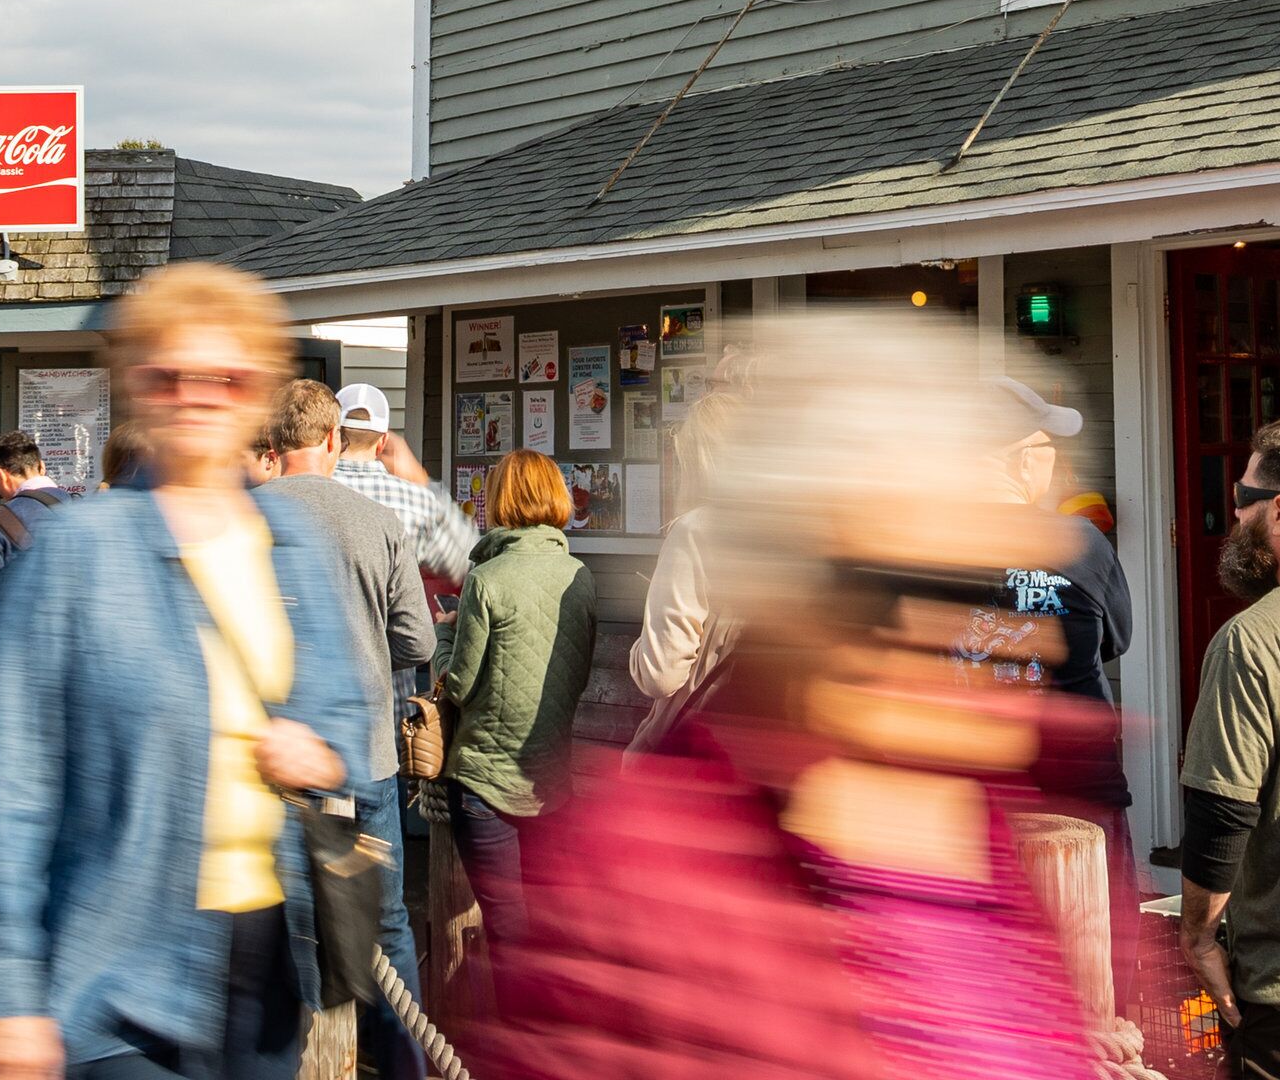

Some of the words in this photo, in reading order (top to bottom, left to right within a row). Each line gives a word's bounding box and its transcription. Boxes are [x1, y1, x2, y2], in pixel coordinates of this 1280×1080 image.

[468, 320, 501, 332] WINNER!
[38, 370, 92, 378] SANDWICHES
[1006, 568, 1029, 588] 75
[1016, 585, 1063, 611] IPA
